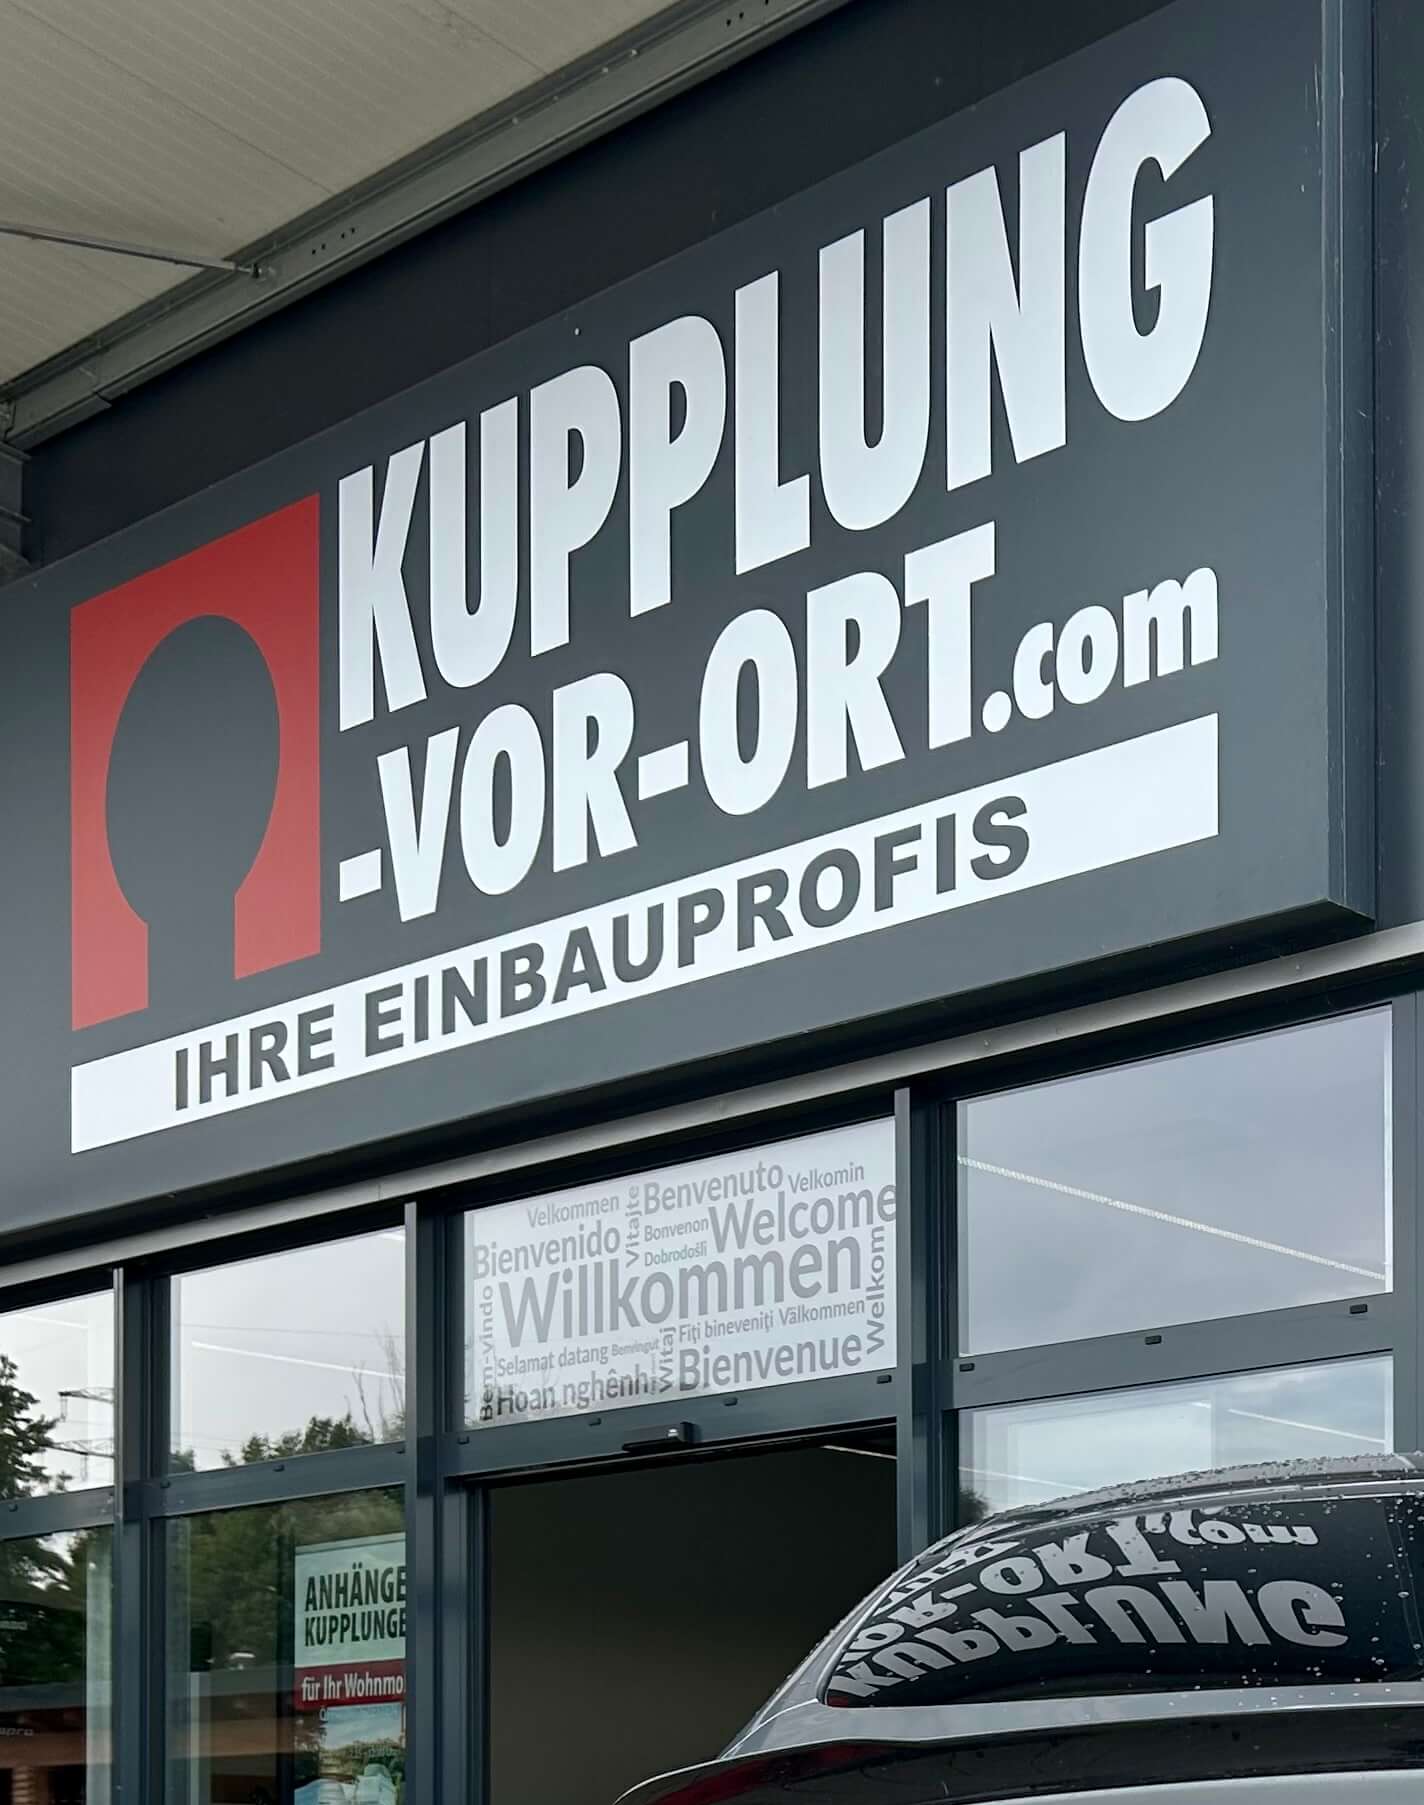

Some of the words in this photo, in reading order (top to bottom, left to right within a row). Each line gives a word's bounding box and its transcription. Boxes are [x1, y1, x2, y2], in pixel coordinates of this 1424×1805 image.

[337, 75, 1216, 732] KUPPLUNG
[337, 520, 1219, 923] -VOR-ORT.com
[174, 1017, 336, 1113] IHRE
[363, 794, 1031, 1055] EINBAUPROFIS
[643, 1160, 783, 1215] Benvenuto
[788, 1162, 865, 1194] Velkomin
[528, 1195, 620, 1229] Velkommen
[625, 1185, 642, 1269] Vitajte
[644, 1217, 709, 1242] Bonvenon
[708, 1184, 897, 1253] Welcome
[473, 1219, 621, 1281] Bienvenido
[499, 1236, 861, 1348] Willkommen
[779, 1300, 865, 1327] Välkommen
[866, 1225, 885, 1354] Welkom
[479, 1285, 494, 1421] Bem-vindo
[497, 1355, 554, 1377] Selamat
[558, 1346, 608, 1367] datang
[659, 1327, 676, 1393] Witaj
[679, 1333, 862, 1392] Bienvenue
[497, 1384, 555, 1415] Hoan
[563, 1363, 648, 1409] nghênh
[304, 1561, 406, 1612] ANHÄNGE
[302, 1675, 320, 1702] für
[323, 1674, 342, 1700] Ihr
[345, 1671, 406, 1698] Wohnmo
